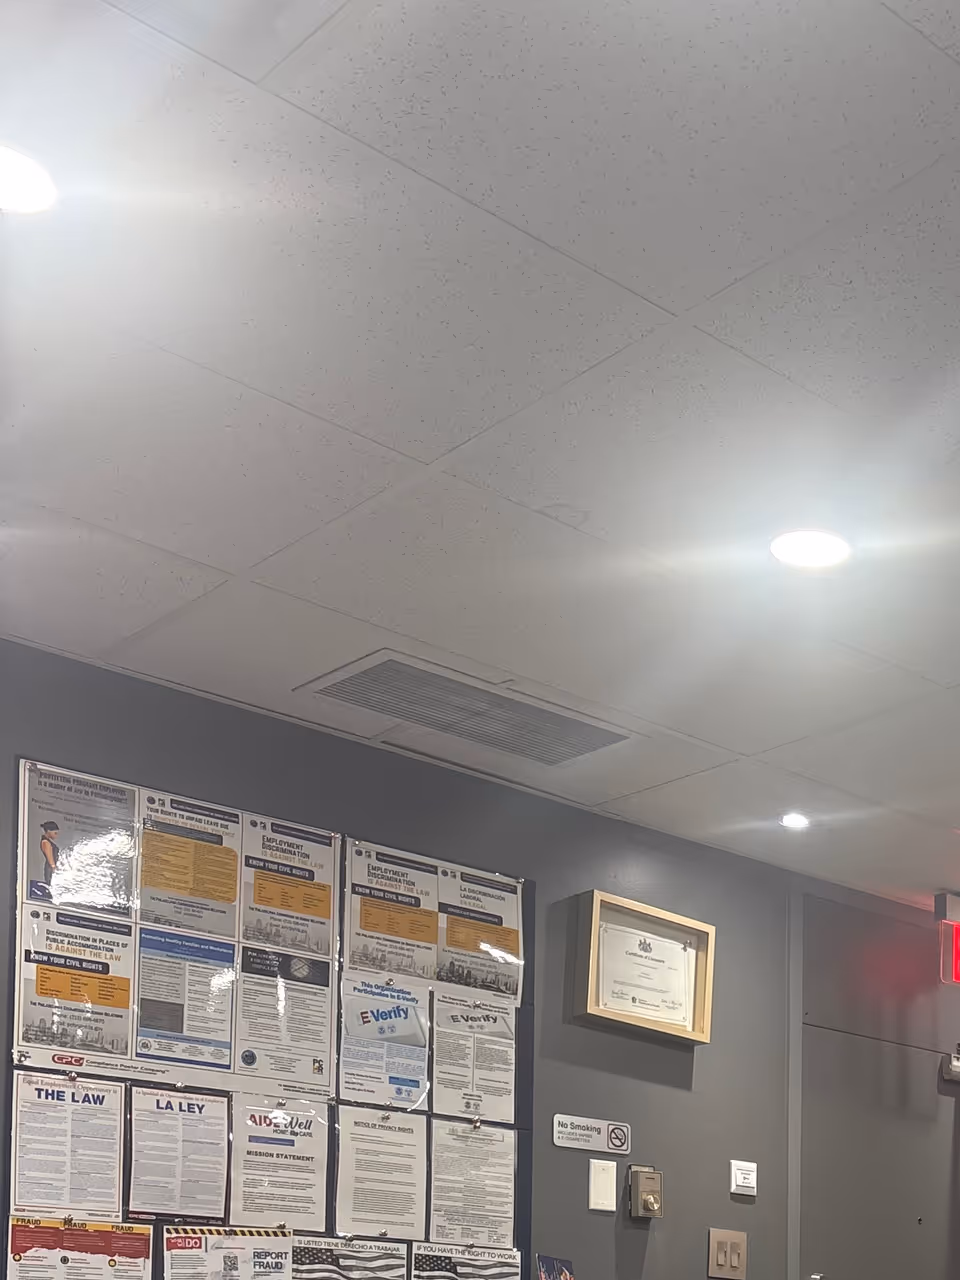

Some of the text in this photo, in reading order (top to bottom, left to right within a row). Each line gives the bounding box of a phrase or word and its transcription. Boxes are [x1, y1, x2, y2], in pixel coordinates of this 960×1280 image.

[262, 835, 303, 851] EMPLOYMENT
[262, 842, 310, 860] DISCRIMINATION
[368, 864, 409, 879] EMPLOYMENT
[368, 871, 416, 887] DISCRIMINATION
[46, 929, 90, 942] DISCRIMINATION
[98, 937, 120, 948] PLACES
[46, 936, 114, 952] PUBLIC ACCOMMODATION
[55, 945, 87, 956] AGAINST
[104, 953, 122, 962] LAW
[30, 953, 103, 971] KNOW YOUR CIVIL RIGHTS
[374, 984, 411, 996] Organization
[53, 1055, 83, 1065] CPC
[22, 1077, 39, 1086] Equal
[41, 1079, 75, 1089] Employment
[77, 1083, 112, 1094] Opportunity
[35, 1088, 106, 1106] THE LAW
[156, 1099, 205, 1114] LA LEY
[570, 1122, 601, 1135] Smoking
[246, 1150, 315, 1162] MISSION STATEMENT
[186, 1238, 200, 1247] DO
[253, 1251, 289, 1260] REPORT
[253, 1261, 283, 1270] FRAUD
